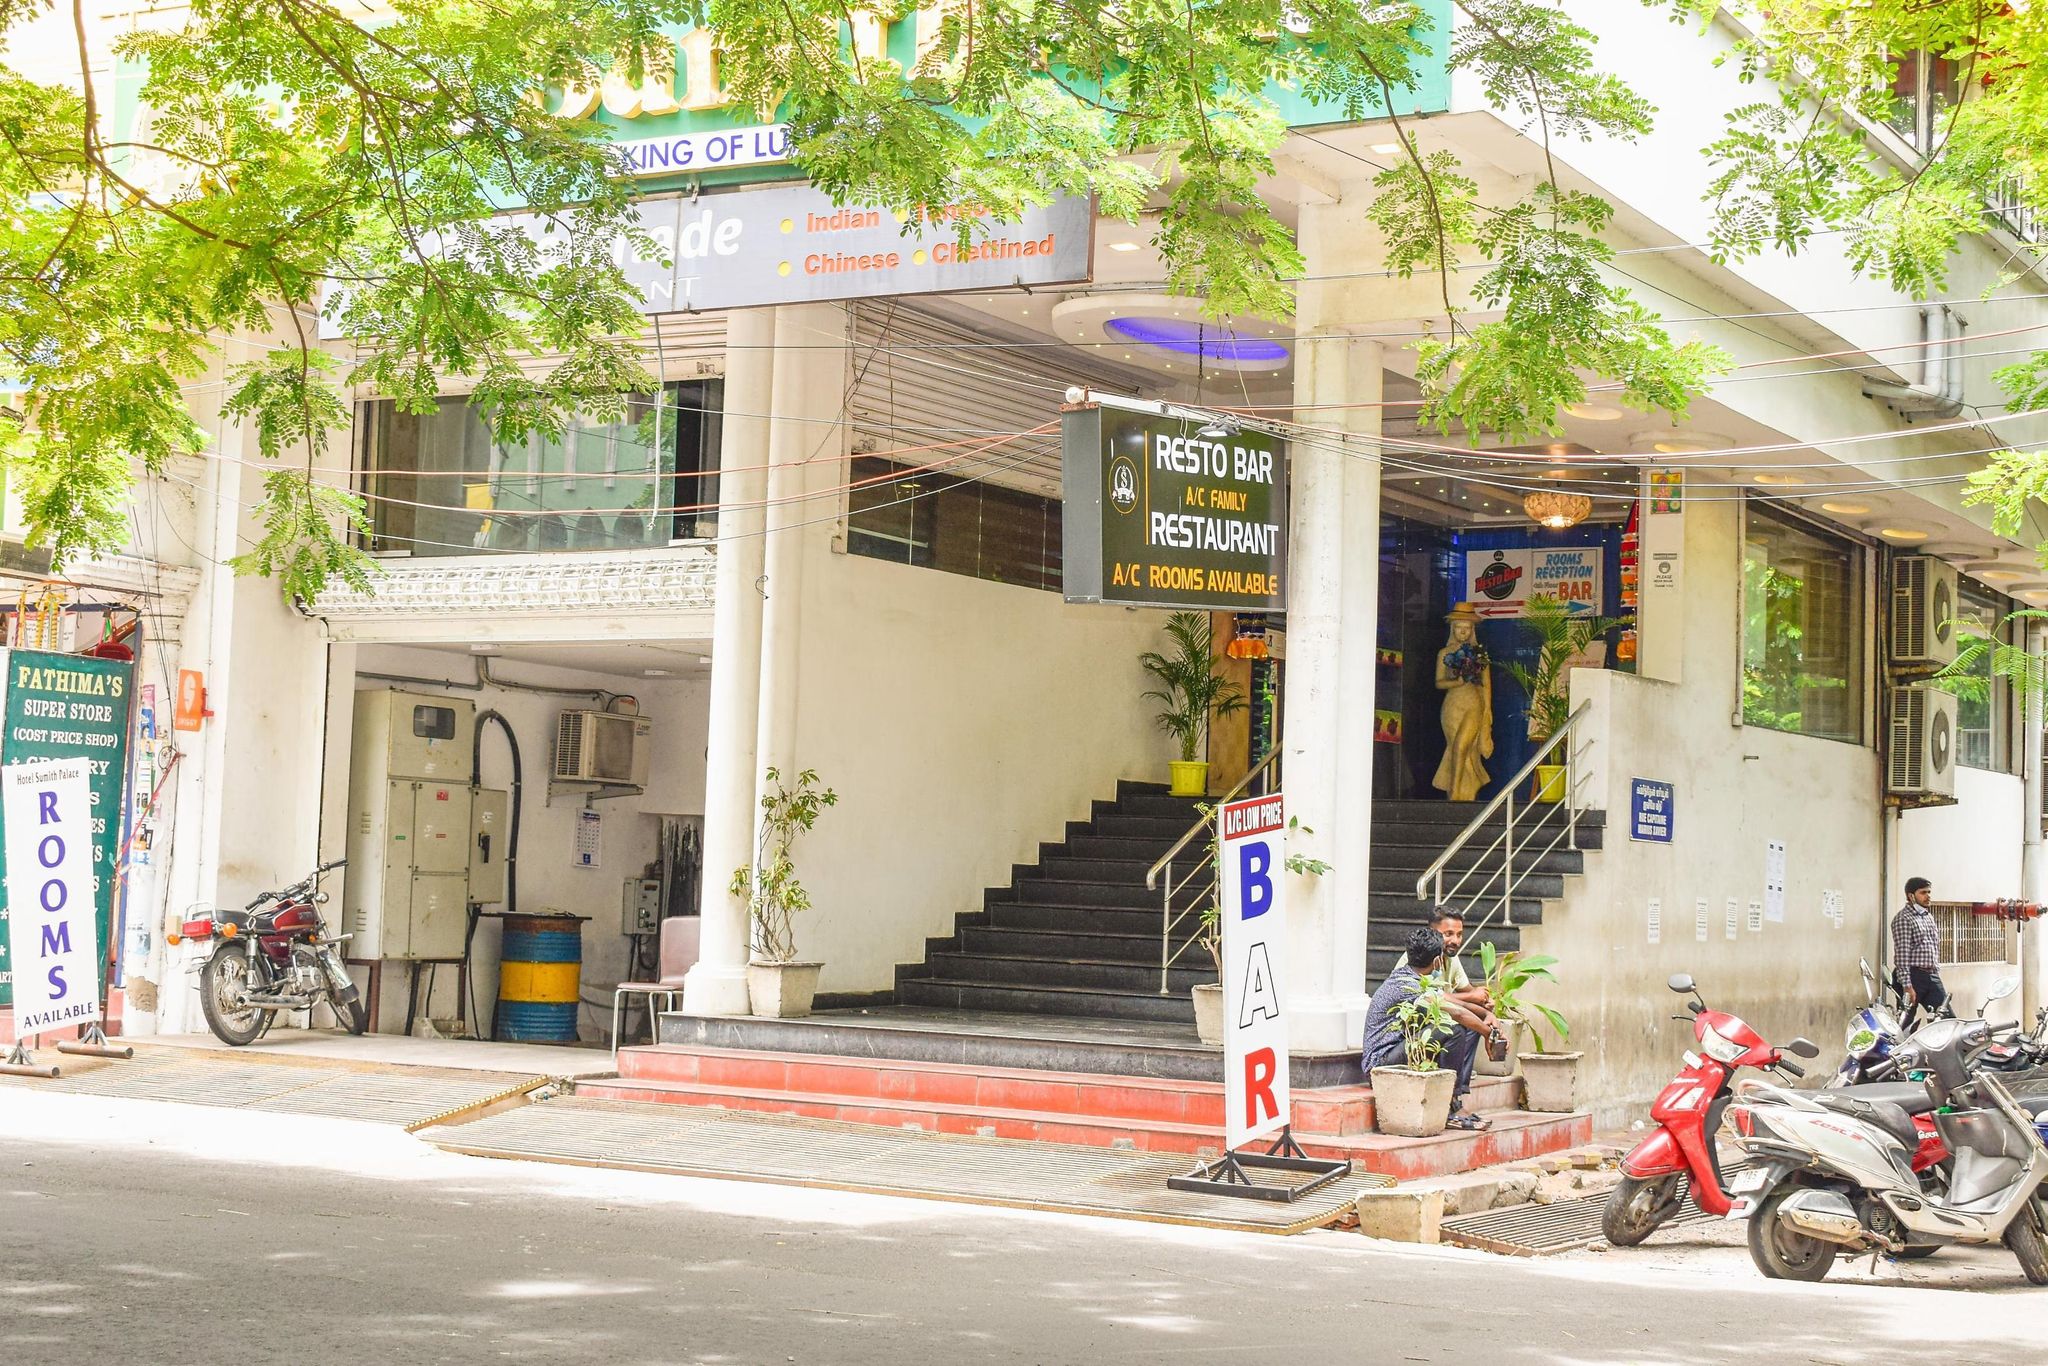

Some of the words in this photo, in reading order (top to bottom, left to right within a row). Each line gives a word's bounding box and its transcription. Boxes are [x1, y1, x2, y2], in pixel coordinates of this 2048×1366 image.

[624, 139, 694, 170] KING
[705, 134, 744, 163] OF
[806, 207, 880, 235] Indian
[803, 247, 900, 277] Chinese
[1155, 433, 1229, 479] RESTO
[1233, 446, 1273, 485] BAR
[1185, 485, 1205, 506] A/C
[1210, 489, 1248, 512] FAMILY
[1150, 511, 1279, 556] RESTAURANT
[1535, 565, 1594, 579] RECEPTION
[1545, 552, 1584, 566] ROOMS
[1112, 562, 1141, 587] A/C
[1149, 565, 1204, 591] ROOMS
[1207, 569, 1278, 596] AVAILABLE
[1558, 580, 1593, 602] BAR
[17, 665, 124, 698] FATHIMA'S
[23, 698, 67, 720] SUPER
[69, 702, 112, 723] STORE
[13, 726, 48, 744] (COST
[50, 729, 83, 746] PRICE
[85, 731, 118, 749] SHOP)
[17, 774, 35, 785] Hotel
[35, 771, 58, 783] Sumith
[58, 768, 80, 779] Palace
[1226, 808, 1242, 835] A/C
[1242, 805, 1260, 832] LOW
[1260, 801, 1282, 828] PRICE
[38, 790, 72, 1000] ROOMS
[1238, 840, 1280, 1130] BAR
[23, 1001, 94, 1029] AVAILABLE
